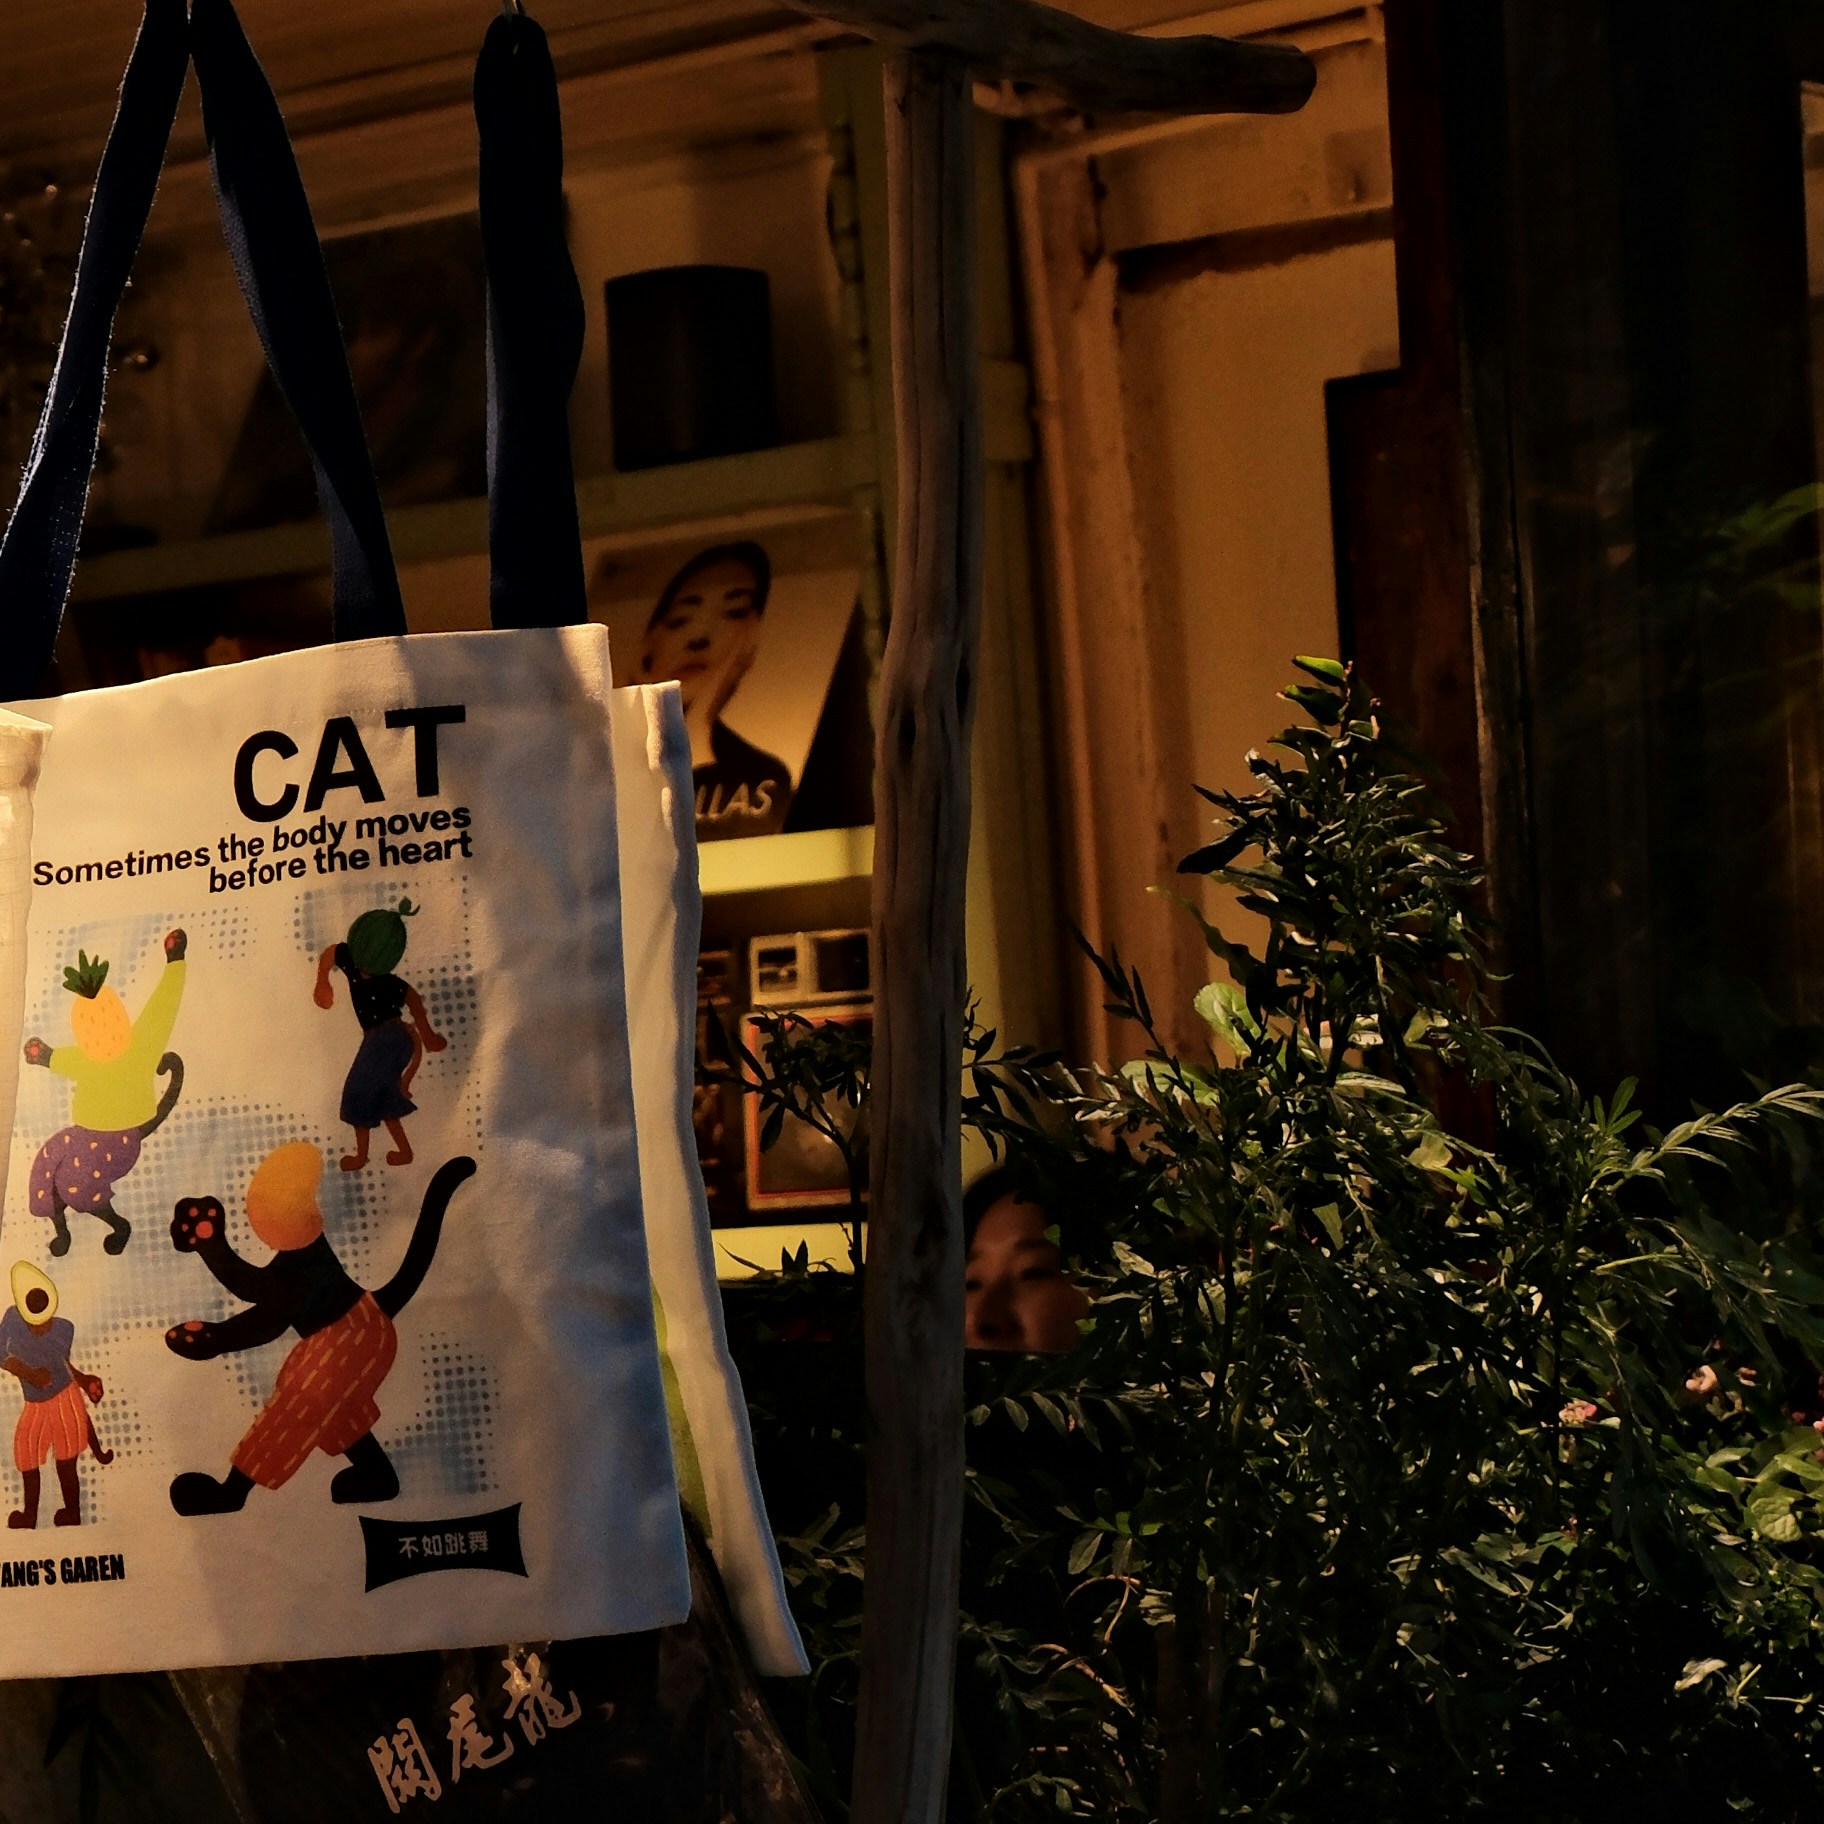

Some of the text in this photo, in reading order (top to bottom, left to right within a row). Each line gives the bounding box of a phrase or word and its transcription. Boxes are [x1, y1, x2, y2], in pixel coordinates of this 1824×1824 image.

[234, 705, 466, 822] CAT
[33, 805, 472, 886] Sometimes the body moves
[209, 831, 473, 893] before the heart
[60, 1554, 125, 1584] GAREN
[398, 1530, 489, 1559] 不如跳舞
